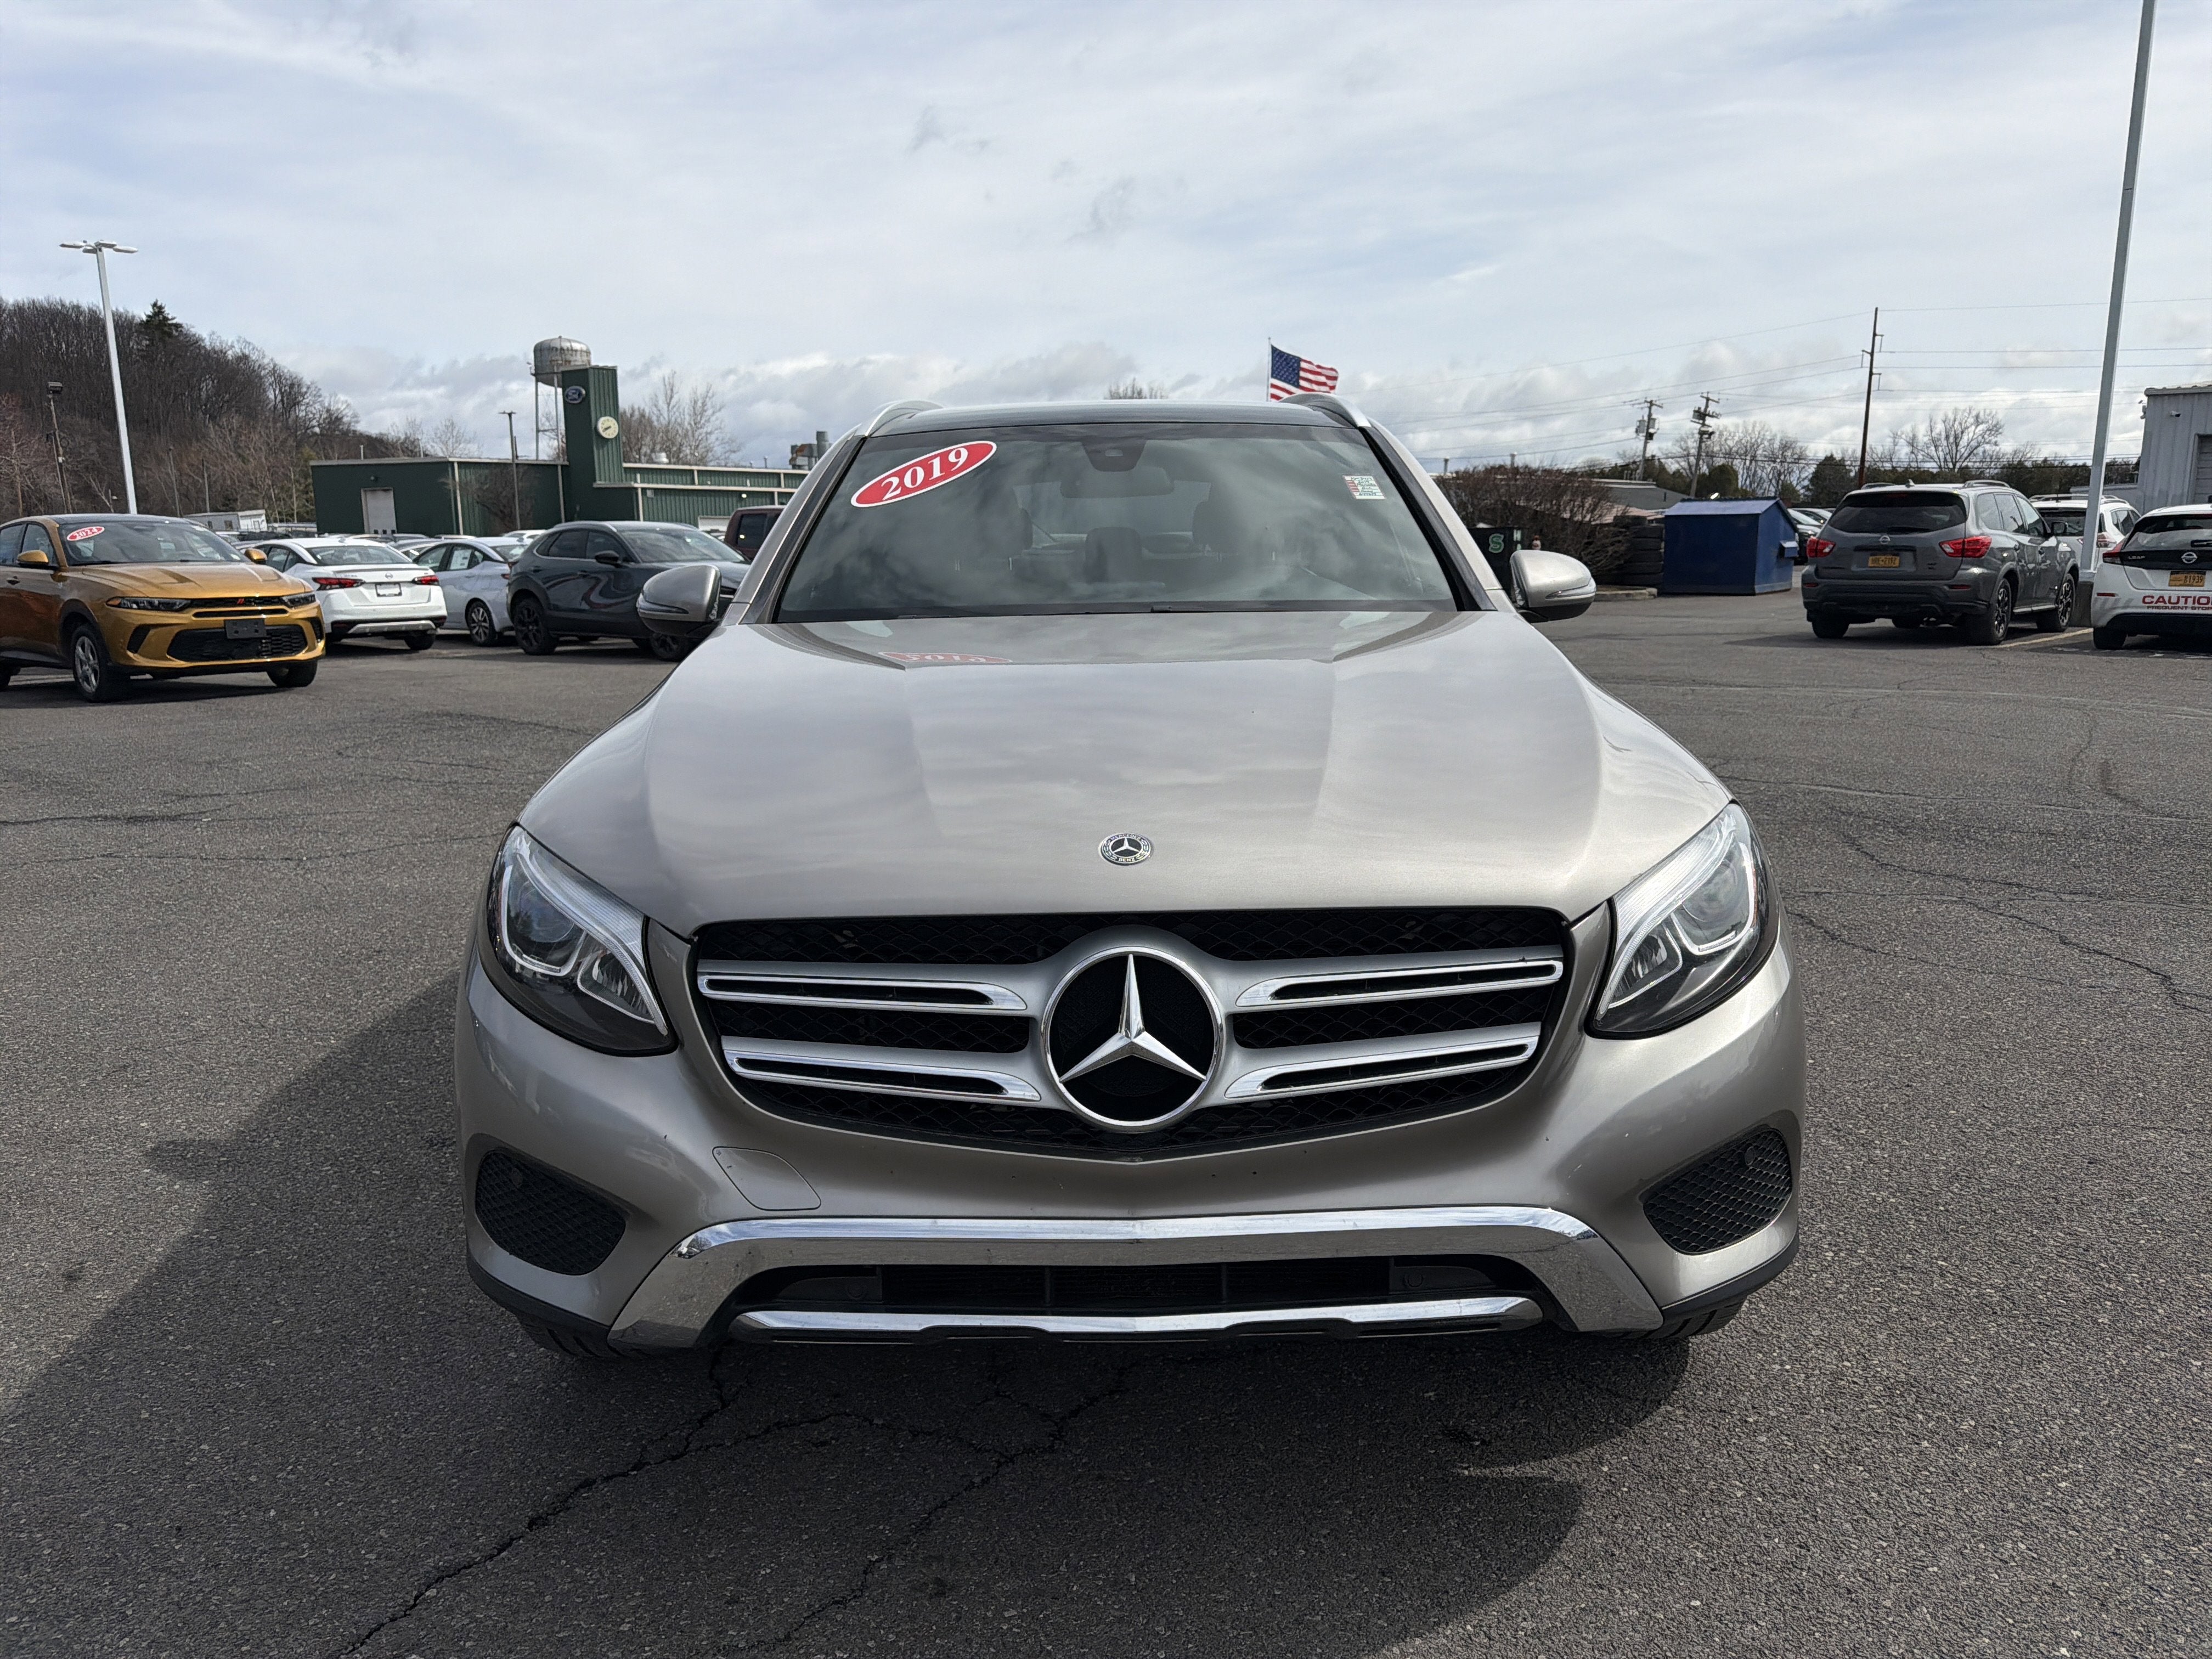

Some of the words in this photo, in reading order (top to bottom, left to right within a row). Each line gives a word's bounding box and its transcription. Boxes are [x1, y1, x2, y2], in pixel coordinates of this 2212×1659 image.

[881, 447, 968, 500] 2019
[72, 527, 98, 538] 2024
[1489, 533, 1504, 553] S
[2142, 595, 2212, 606] CAUTIO
